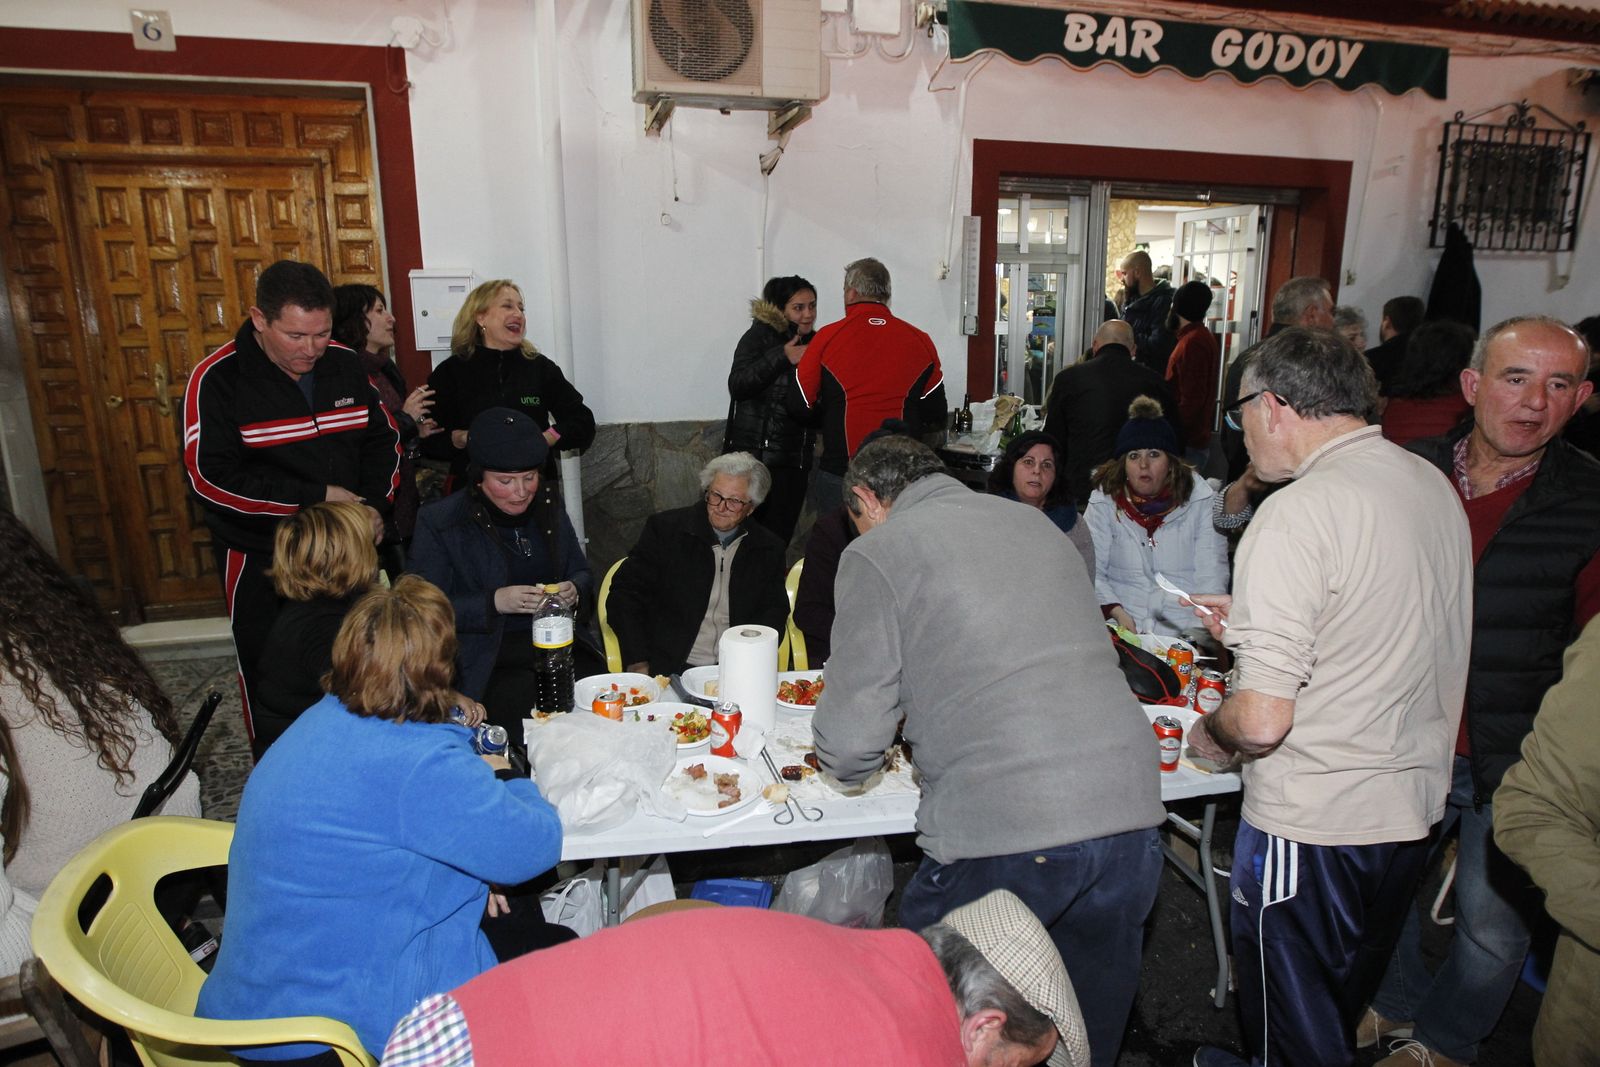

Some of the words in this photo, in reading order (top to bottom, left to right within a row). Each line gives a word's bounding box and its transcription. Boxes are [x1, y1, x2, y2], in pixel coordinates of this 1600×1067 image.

[142, 22, 162, 41] 6
[1063, 13, 1164, 63] BAR
[1211, 28, 1364, 79] GODOY
